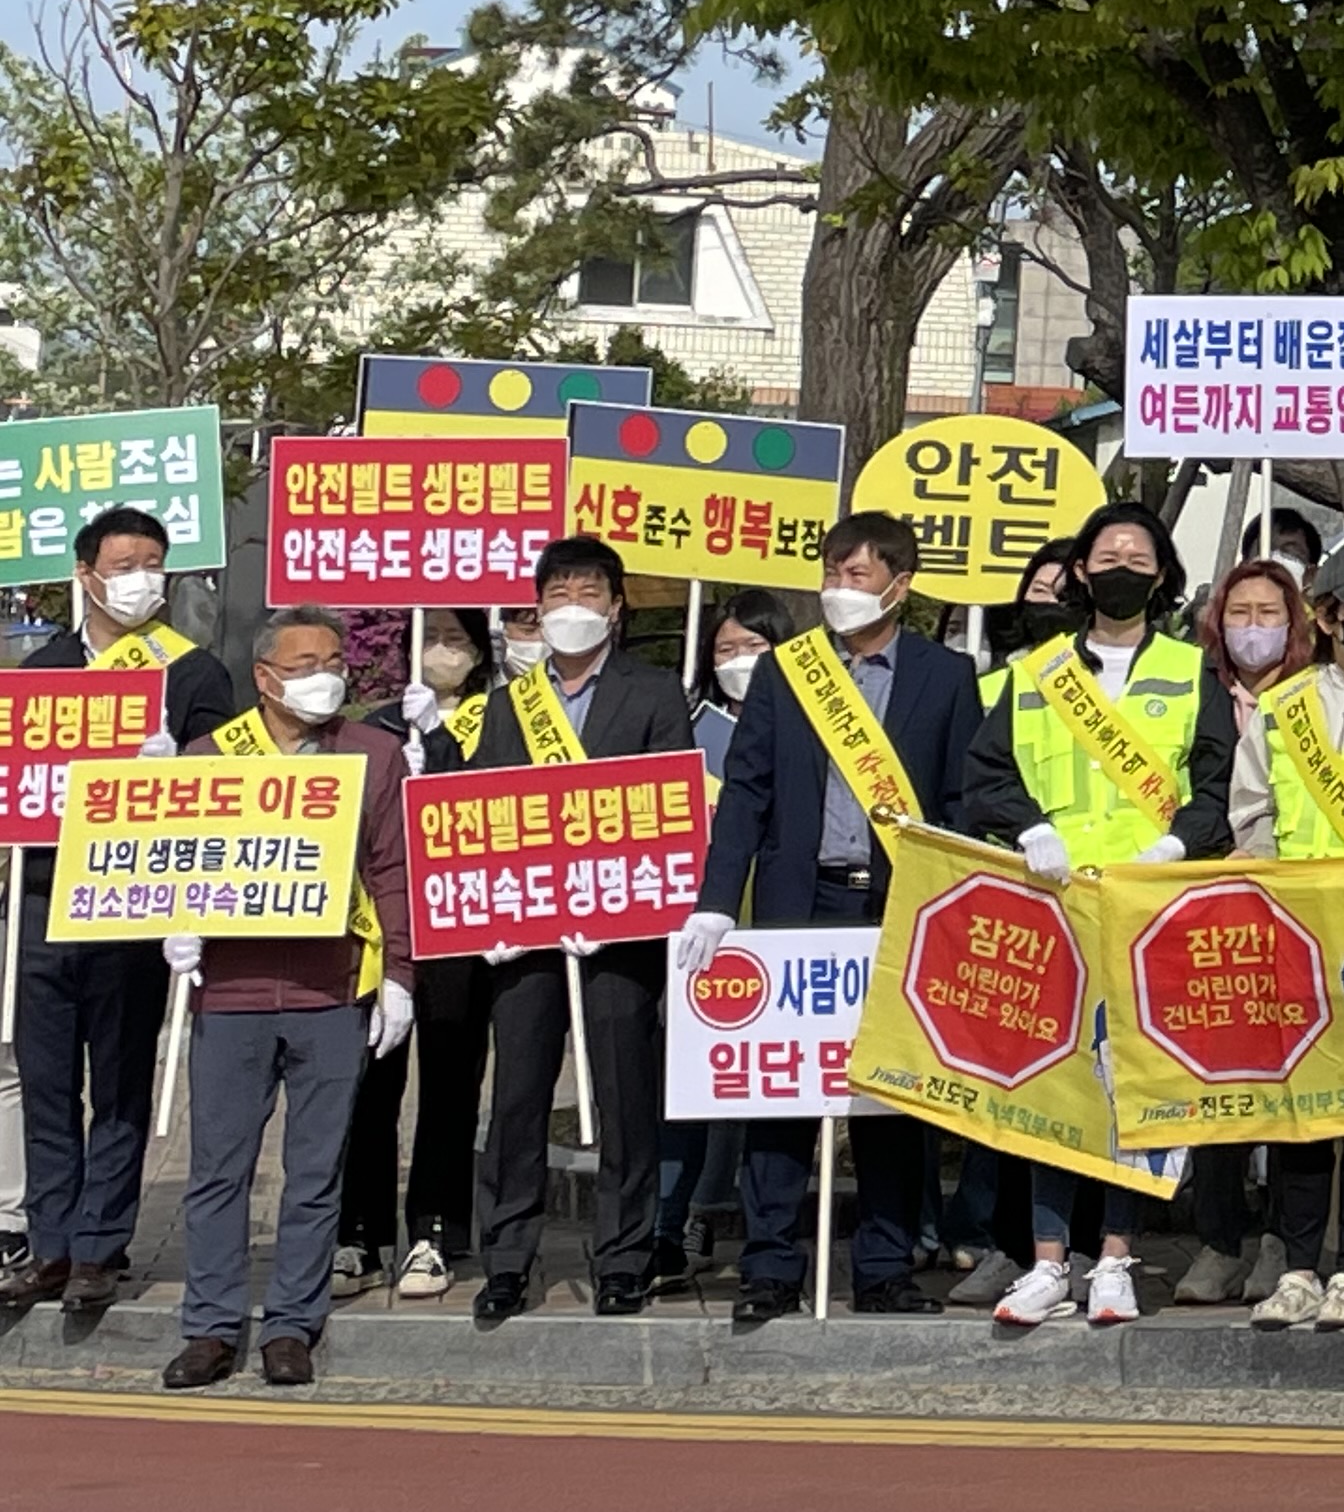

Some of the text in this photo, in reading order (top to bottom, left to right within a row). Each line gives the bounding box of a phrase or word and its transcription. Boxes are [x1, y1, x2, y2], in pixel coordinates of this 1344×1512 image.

[1140, 318, 1264, 369] 세살부터
[1140, 384, 1262, 434] 여든까지
[35, 434, 199, 493] 사람조심
[286, 462, 552, 514] 안전벨트 생명벨트
[906, 440, 1059, 507] 안전
[574, 483, 826, 561] 신호준수 행복보장
[902, 514, 1049, 575] 벨트
[283, 528, 549, 581] 안전속도 생명속도
[22, 694, 148, 751] 생명벨트
[84, 775, 341, 823] 횡단보도 이용
[421, 781, 694, 859] 안전벨트 생명벨트
[89, 837, 321, 875] 나의 생명을 지키는
[69, 881, 329, 920] 최소한의 약속입니다
[424, 851, 698, 929] 안전속도 생명속도
[968, 914, 1056, 975] 잠깐!
[1186, 924, 1276, 969] 잠깐!
[695, 978, 762, 1000] STOP
[777, 957, 869, 1016] 사람이
[957, 962, 1040, 1007] 어린이가
[1187, 974, 1277, 1001] 어린이가
[926, 979, 1059, 1043] 건너고 있어요
[1163, 1000, 1308, 1031] 건너고 있어요
[709, 1040, 858, 1099] 일단 멈
[926, 1075, 980, 1113] 진도군
[1199, 1094, 1255, 1118] 진도군
